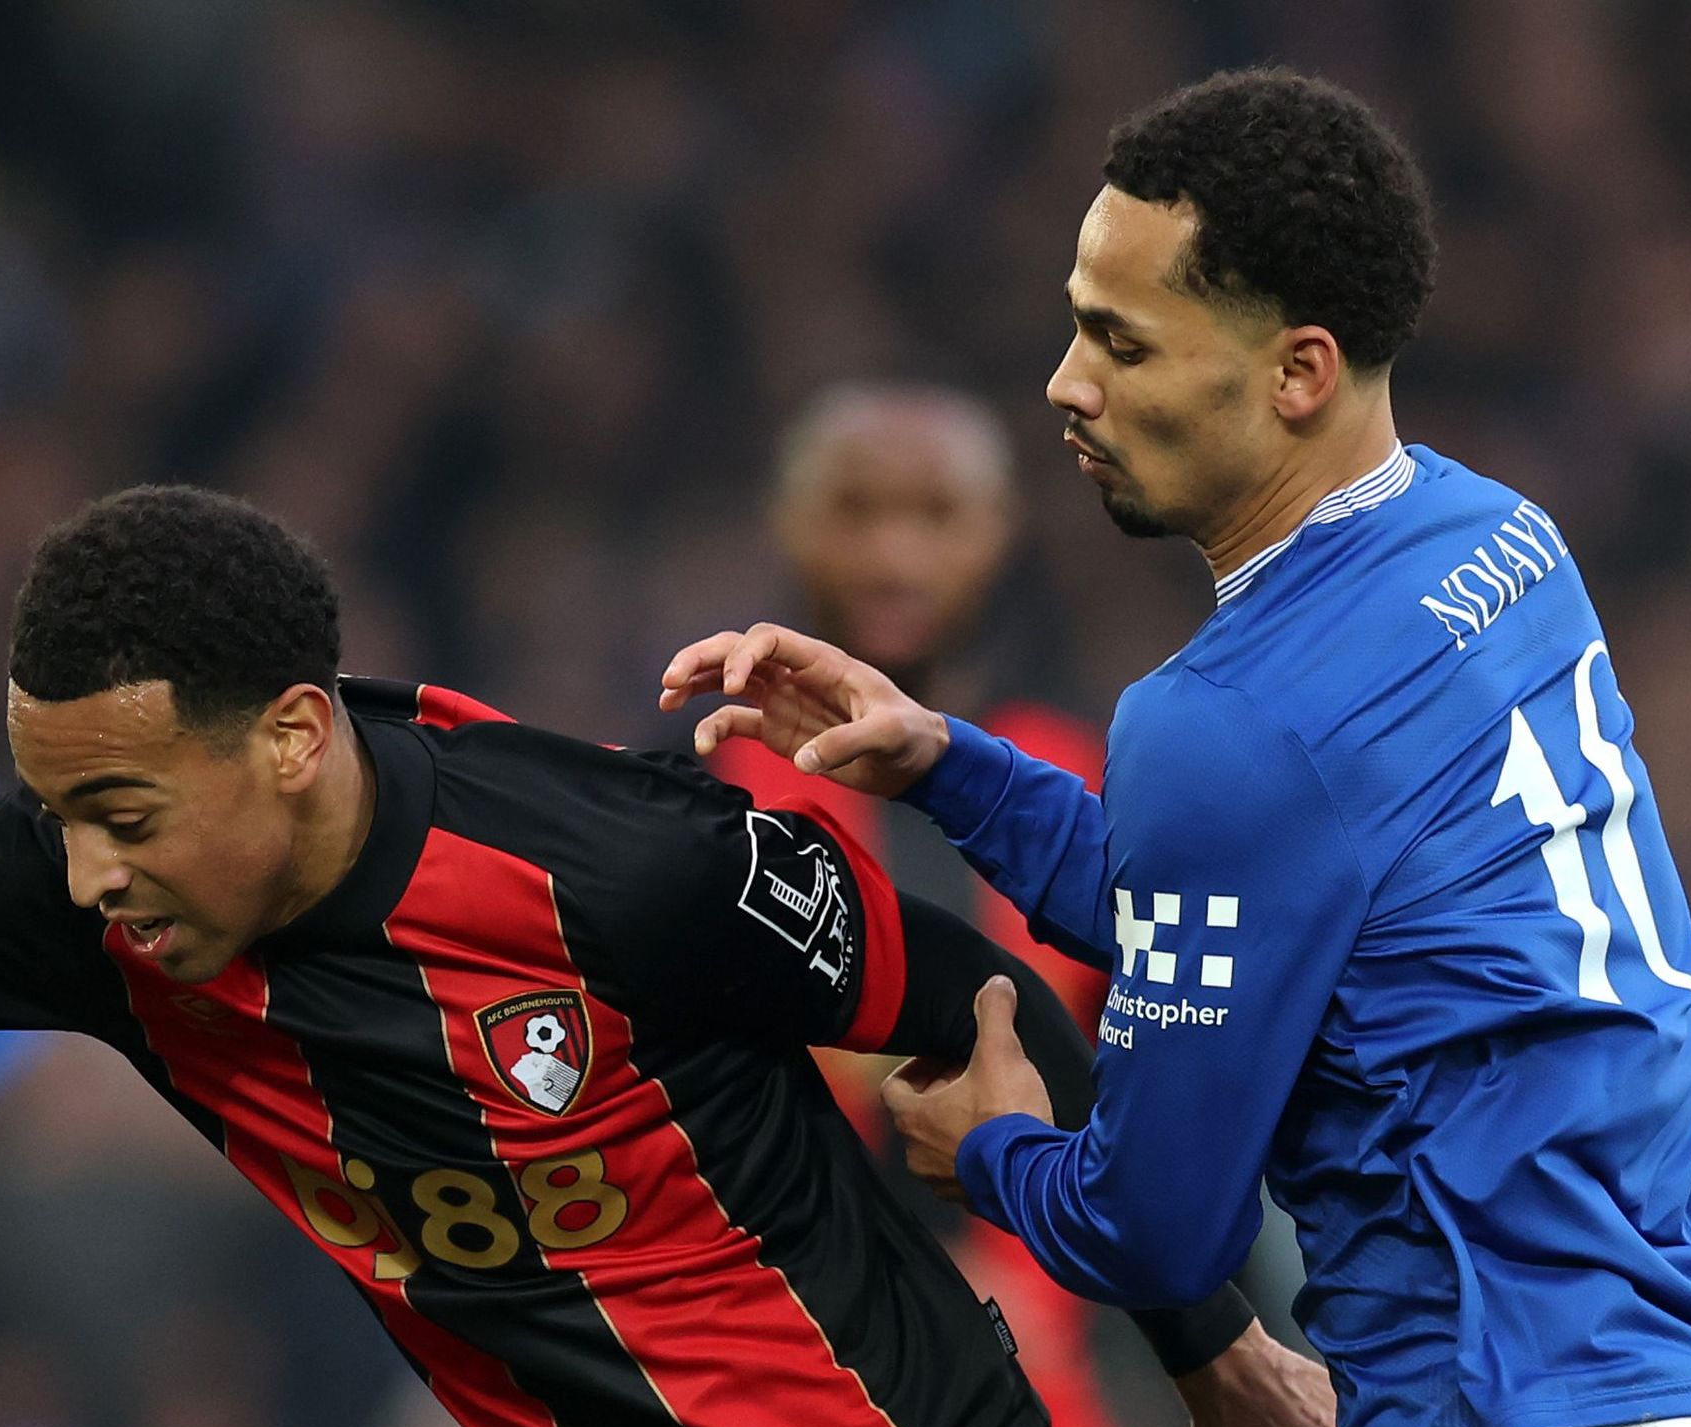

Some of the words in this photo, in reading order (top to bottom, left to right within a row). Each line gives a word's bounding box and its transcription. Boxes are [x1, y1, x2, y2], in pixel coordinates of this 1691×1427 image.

[487, 1011, 503, 1026] AFC
[504, 997, 574, 1017] BOURNEMOUTH
[1107, 984, 1229, 1030] Christopher
